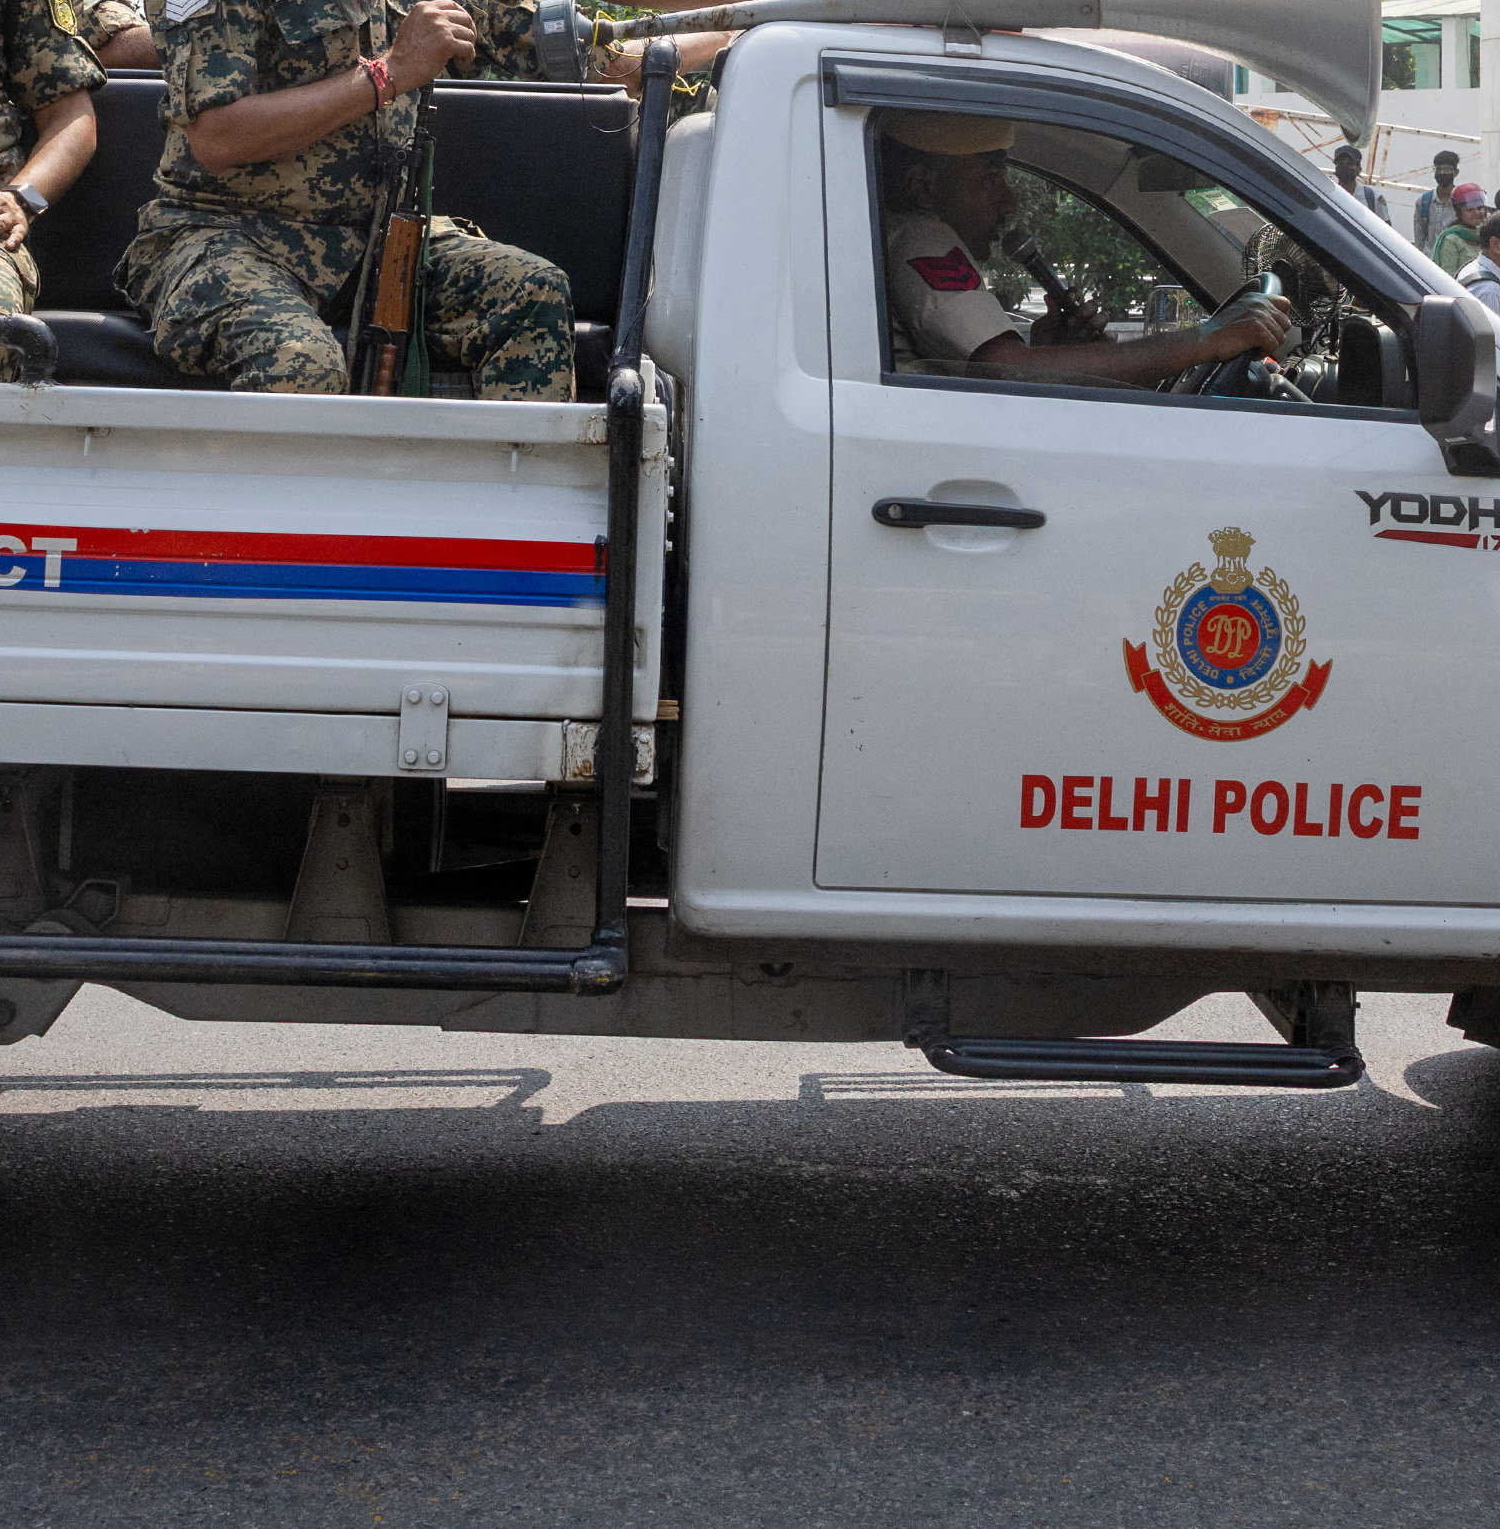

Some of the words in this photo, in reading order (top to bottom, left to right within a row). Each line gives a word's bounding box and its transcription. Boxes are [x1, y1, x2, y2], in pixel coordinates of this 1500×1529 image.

[1183, 600, 1208, 646] POLICE
[1205, 614, 1252, 659] DP
[1187, 649, 1219, 680] DELHI
[1208, 722, 1242, 738] सेवा
[1250, 708, 1288, 731] न्याय
[1020, 774, 1191, 833] DELHI
[1212, 779, 1422, 840] POLICE
